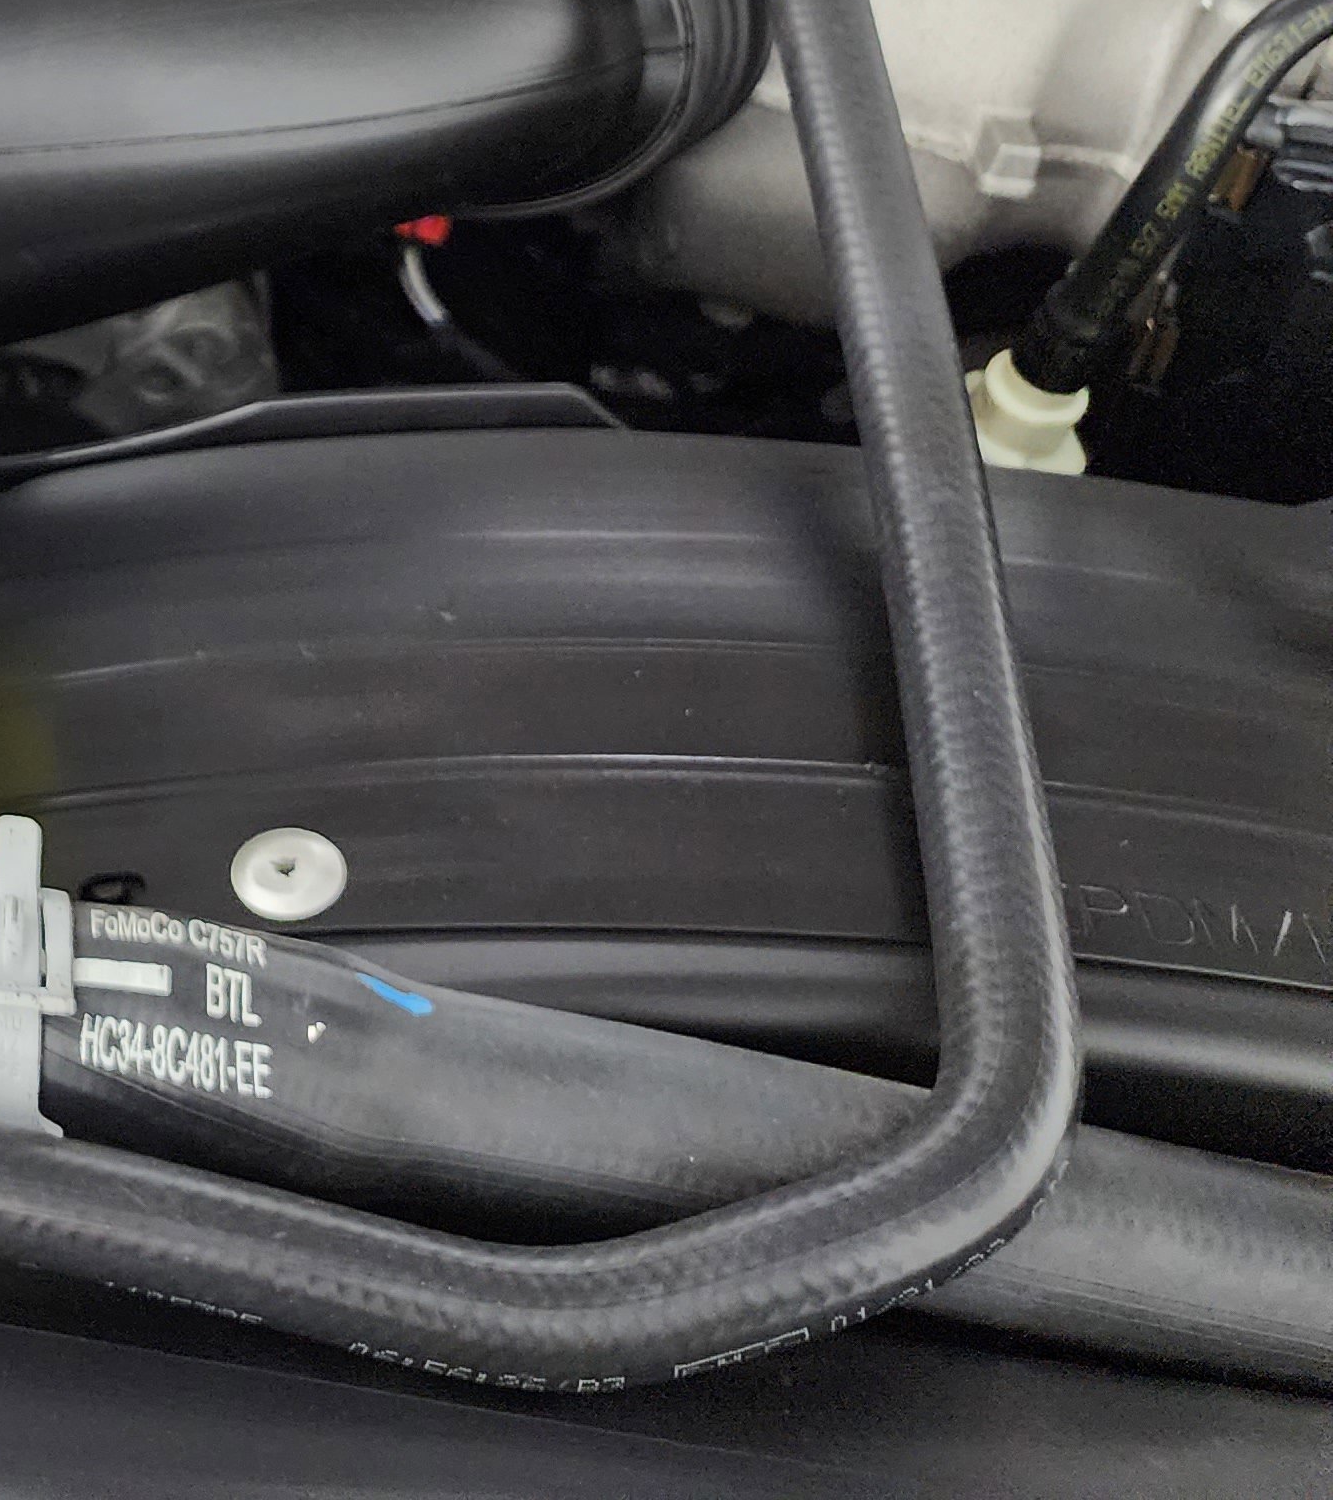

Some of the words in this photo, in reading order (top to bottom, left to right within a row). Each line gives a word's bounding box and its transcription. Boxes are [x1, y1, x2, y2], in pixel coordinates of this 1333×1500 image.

[90, 908, 185, 946] FoMoCo
[187, 918, 268, 969] C757R
[205, 962, 263, 1028] BTL
[79, 1012, 274, 1100] HC34-8C481-EE
